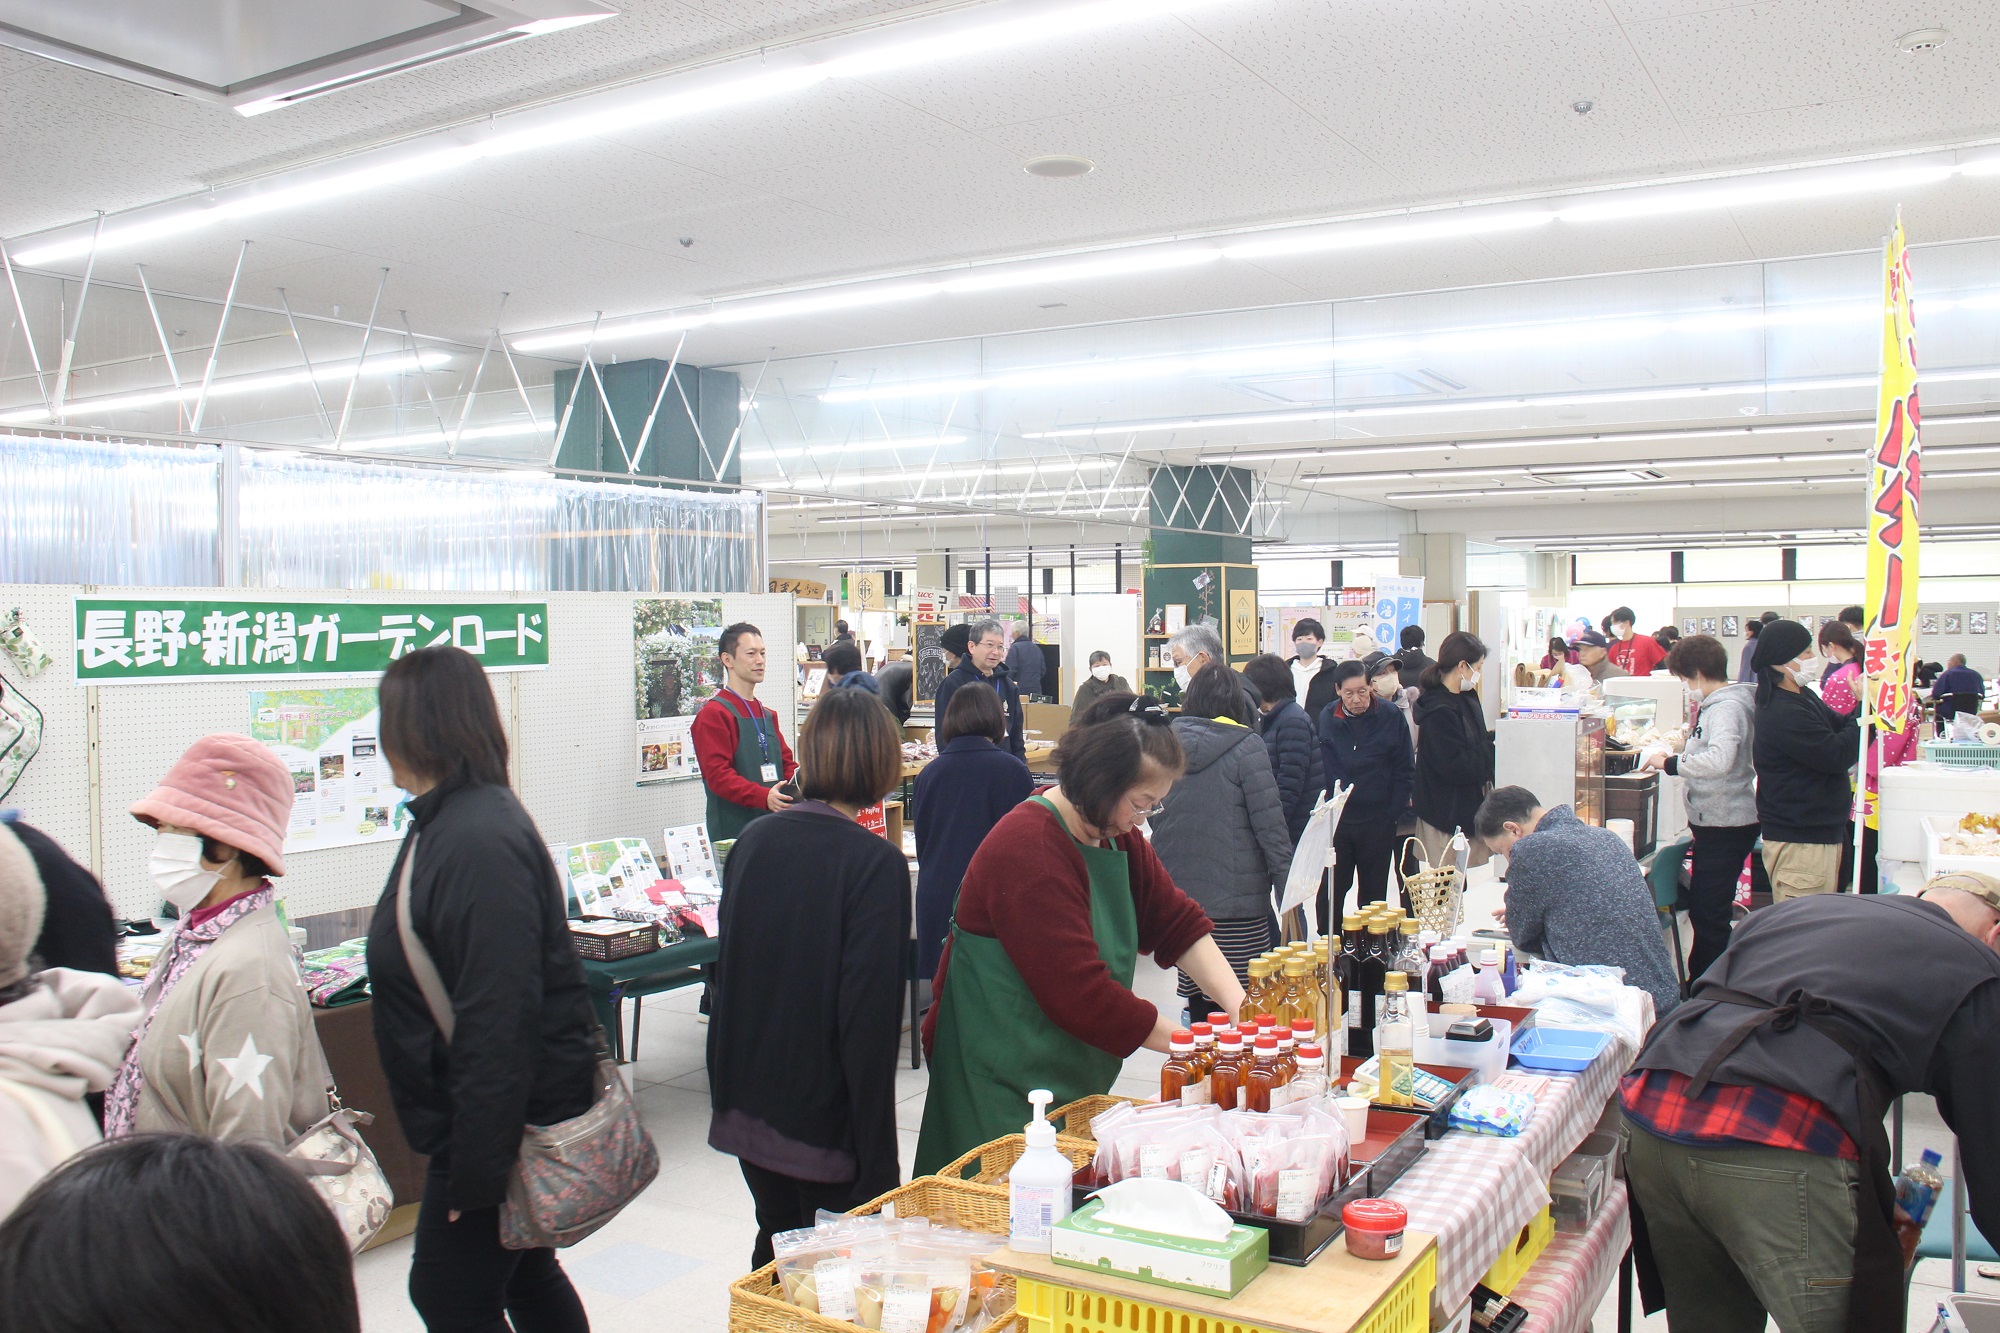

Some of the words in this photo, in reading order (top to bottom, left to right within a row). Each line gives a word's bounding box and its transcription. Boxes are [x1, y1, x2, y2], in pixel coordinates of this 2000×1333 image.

[78, 609, 543, 669] 長野・新潟ガーデンロード
